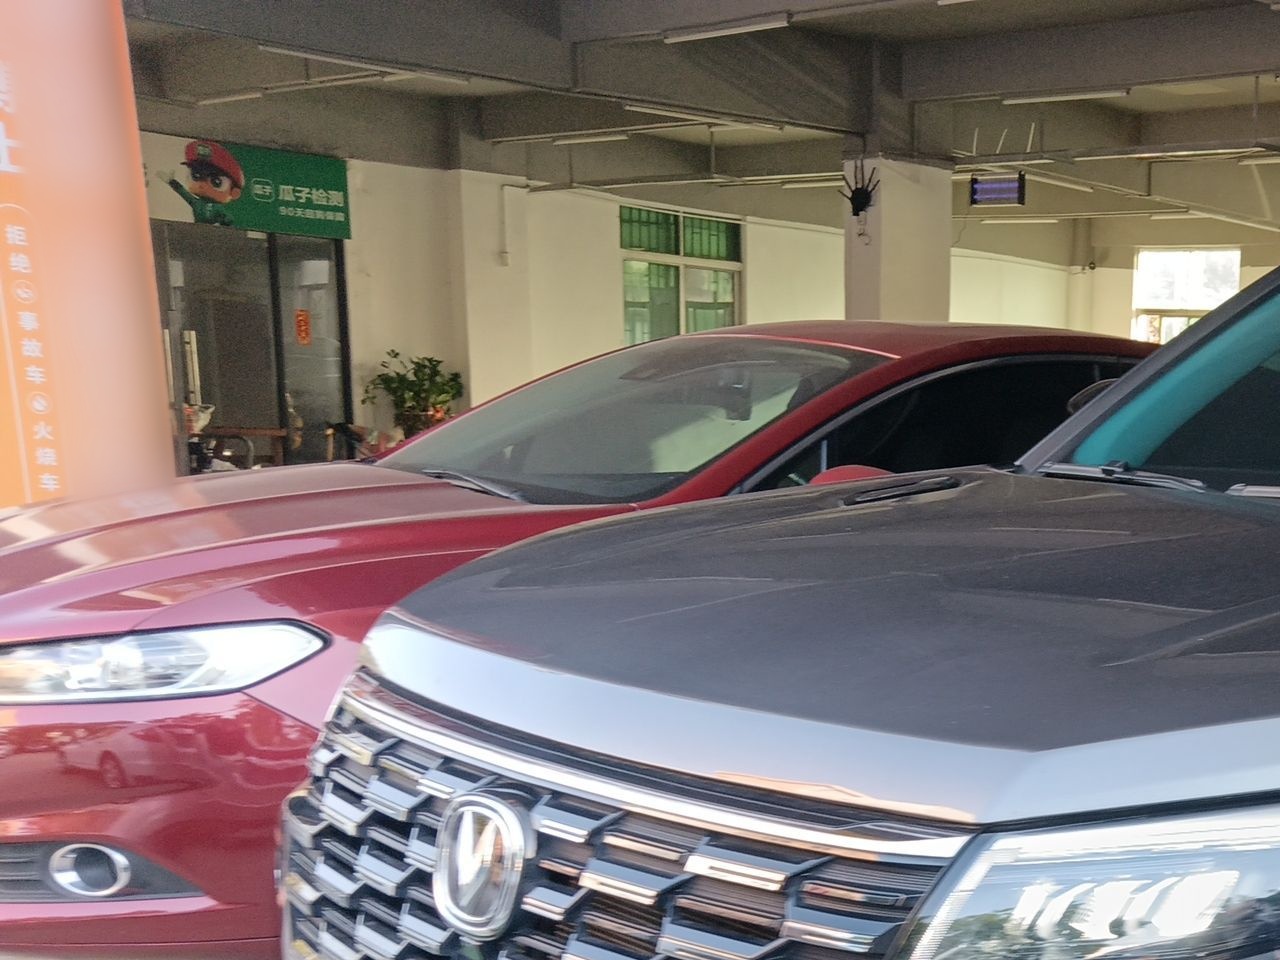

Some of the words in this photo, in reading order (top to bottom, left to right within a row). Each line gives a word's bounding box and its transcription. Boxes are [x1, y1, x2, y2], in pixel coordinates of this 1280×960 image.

[278, 185, 345, 207] 瓜子检测
[5, 223, 32, 274] 拒绝
[17, 311, 46, 384] 事故车
